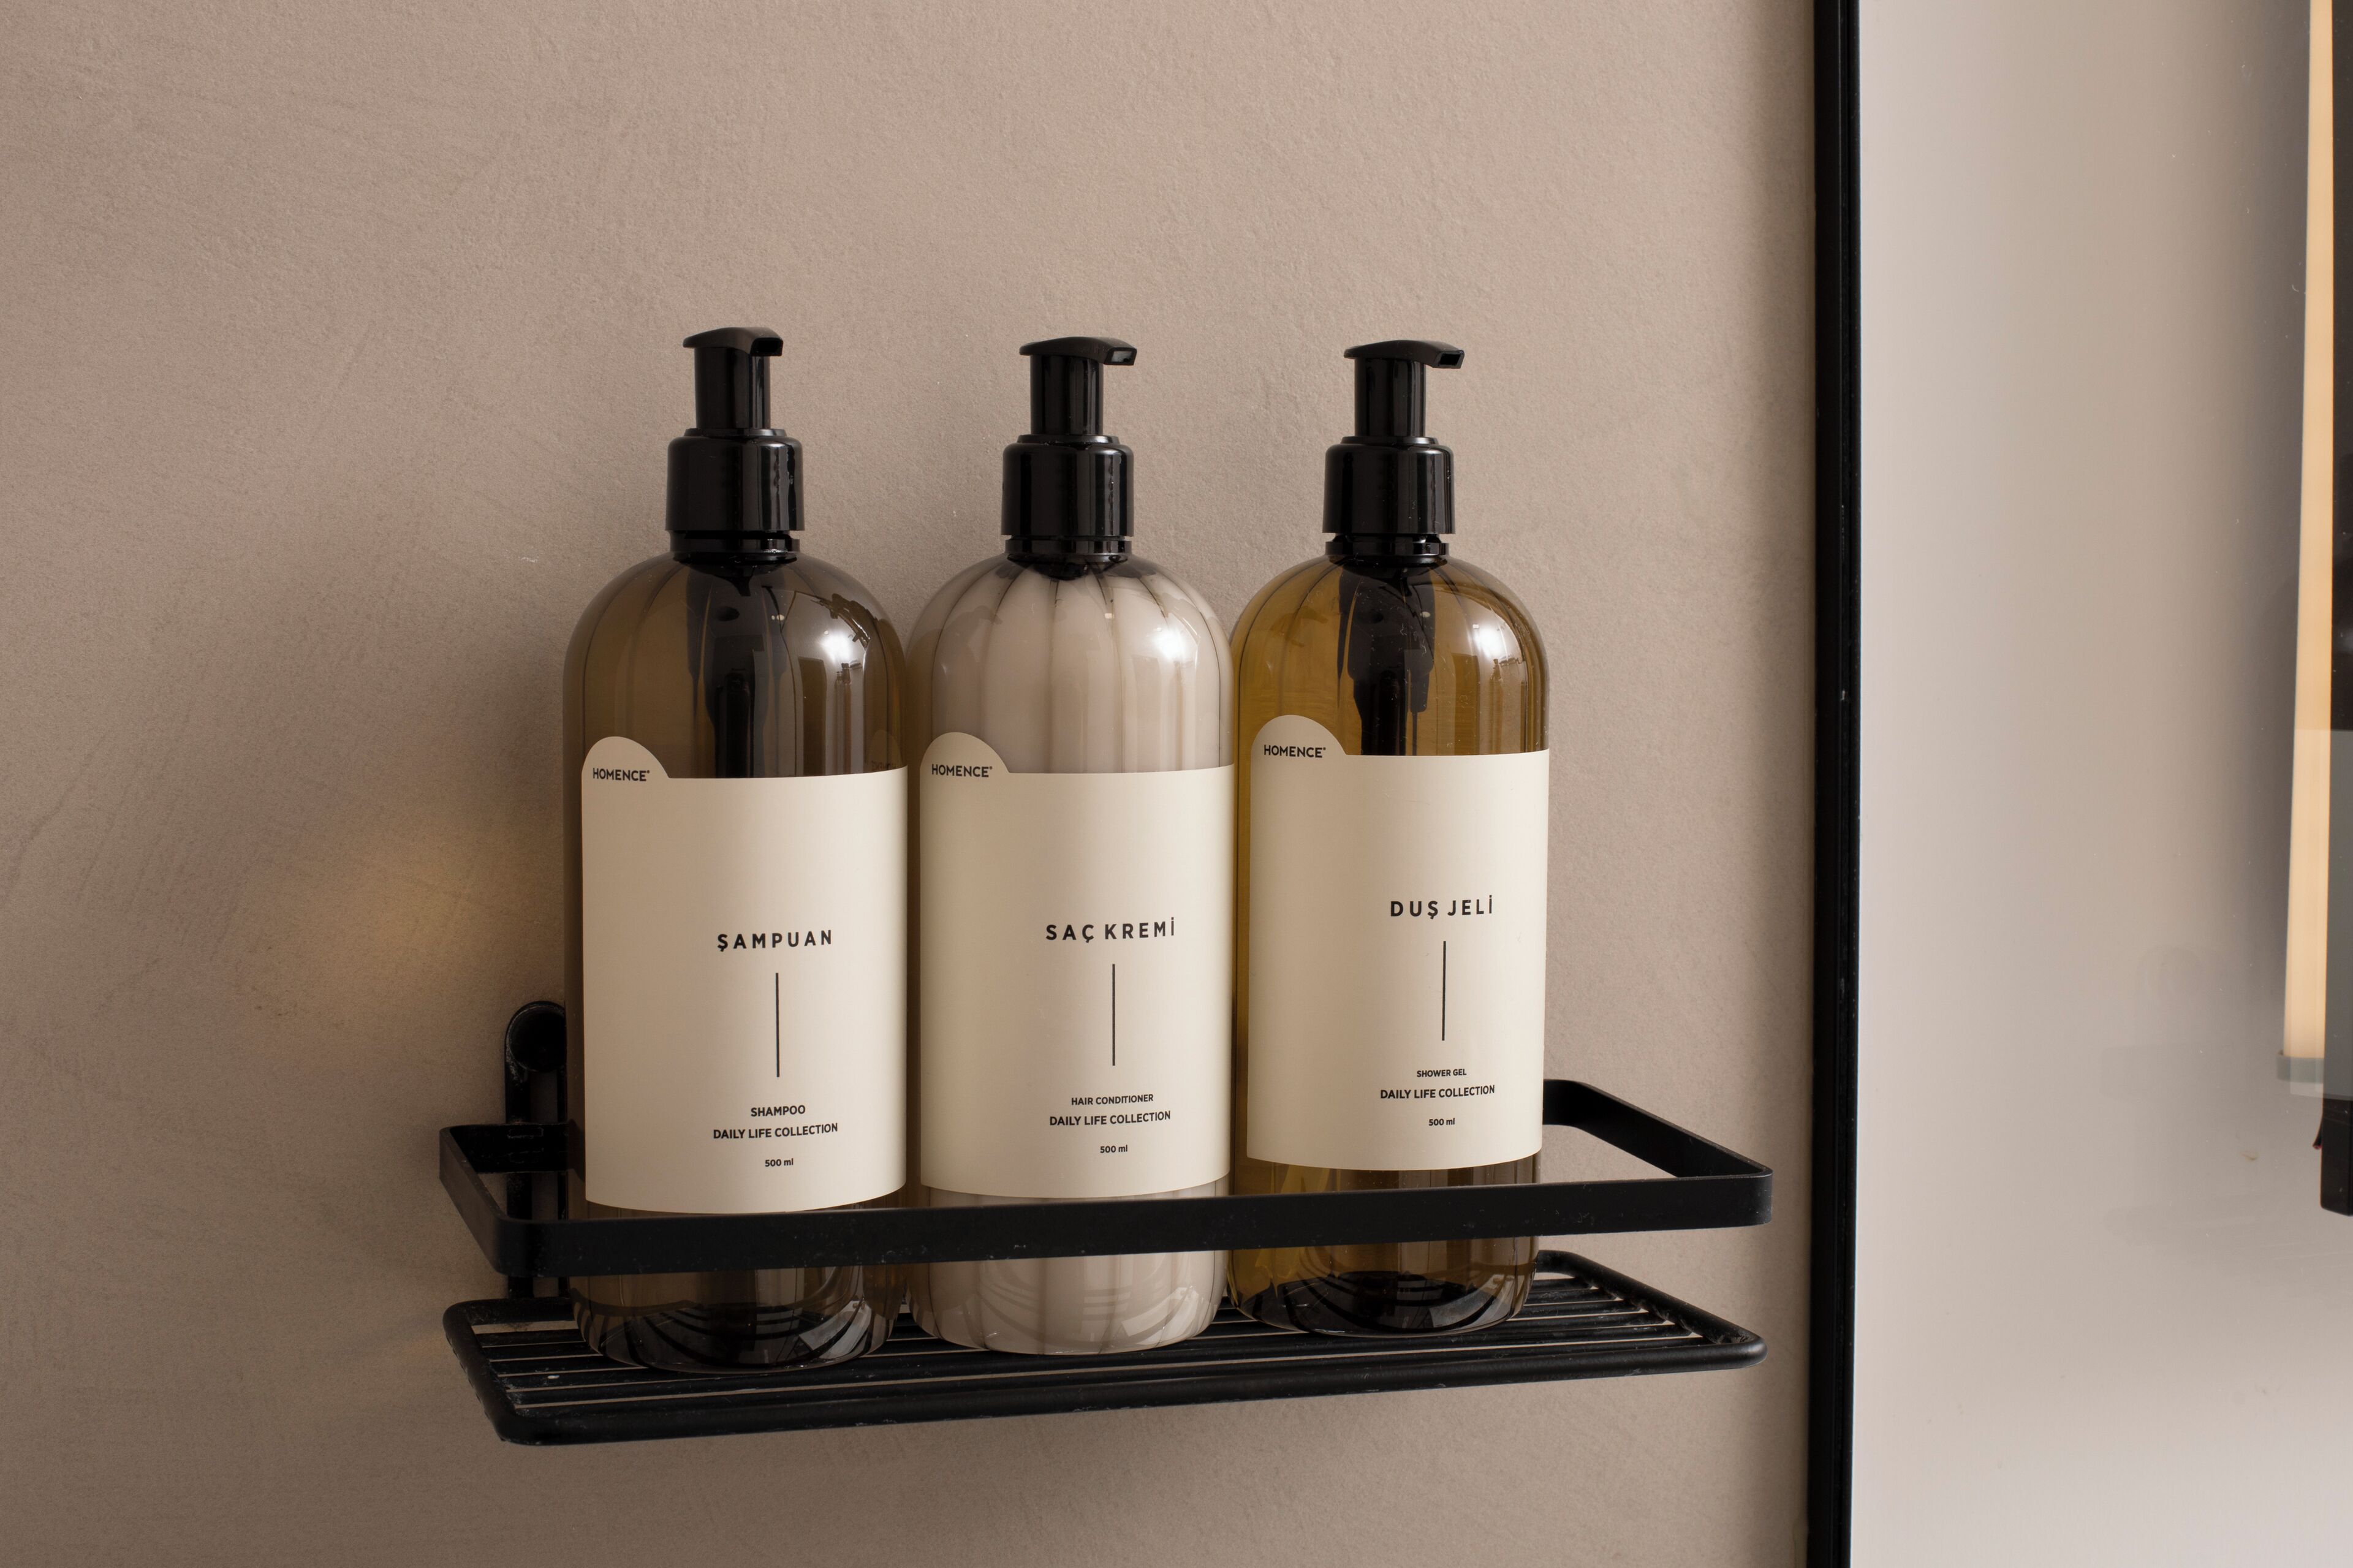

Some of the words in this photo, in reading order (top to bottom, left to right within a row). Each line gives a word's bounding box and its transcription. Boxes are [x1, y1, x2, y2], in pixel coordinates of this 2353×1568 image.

[1390, 901, 1438, 920] DUŞ
[1447, 895, 1492, 916] JELİ
[1045, 924, 1094, 943] SAÇ
[1105, 917, 1174, 939] KREMİ
[718, 930, 832, 952] ŞAMPUAN
[1096, 1094, 1154, 1105] CONDITIONER
[1380, 1089, 1411, 1099] DAILY
[1414, 1089, 1436, 1098] LIFE
[1438, 1085, 1495, 1097] COLLECTION
[751, 1105, 806, 1117] SHAMPOO
[1050, 1116, 1082, 1126] DAILY
[1084, 1116, 1107, 1125] LIFE
[1110, 1110, 1171, 1124] COLLECTION
[713, 1129, 745, 1139] DAILY
[748, 1128, 771, 1138] LIFE
[775, 1123, 838, 1137] COLLECTION
